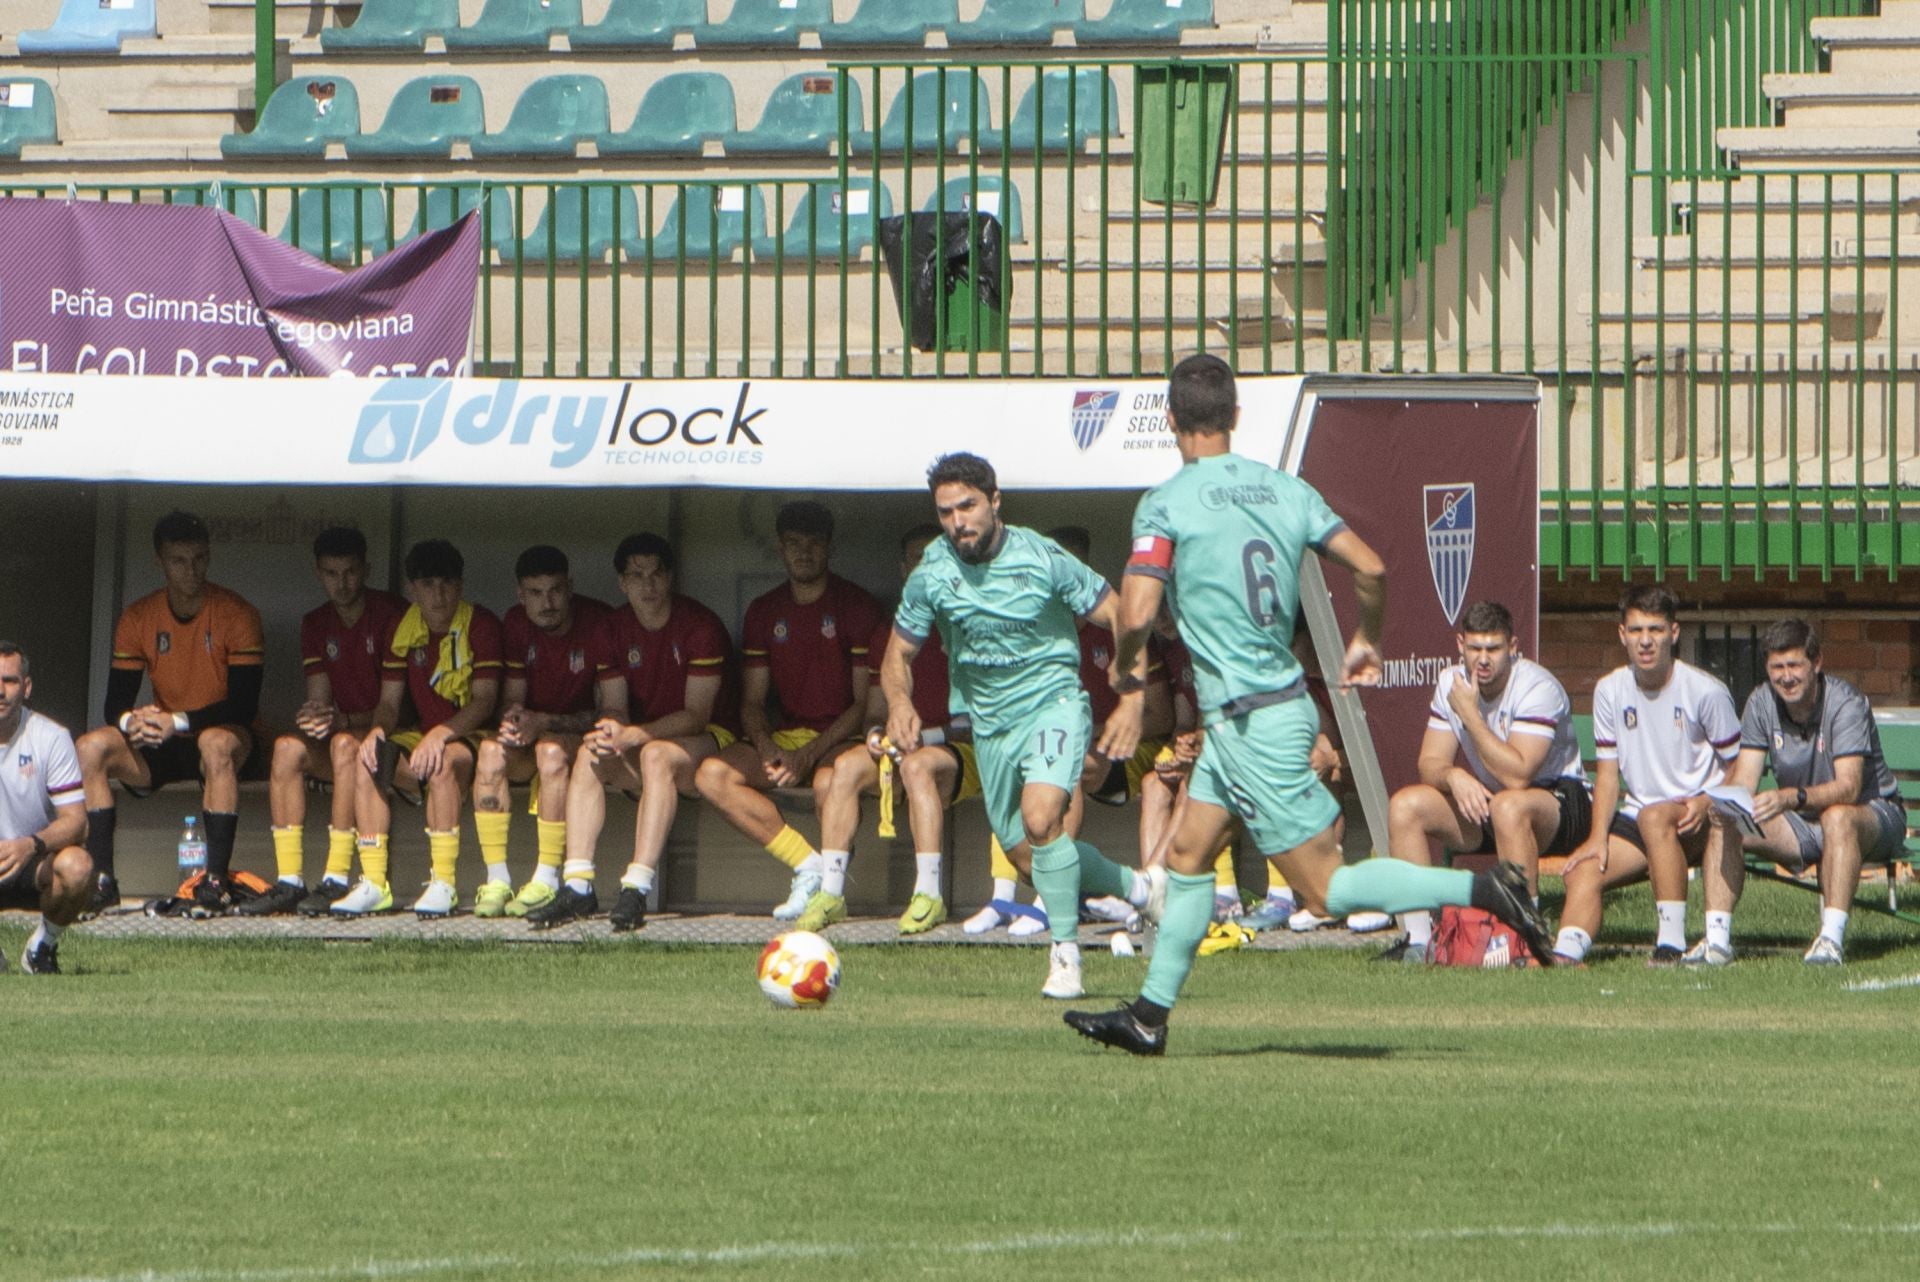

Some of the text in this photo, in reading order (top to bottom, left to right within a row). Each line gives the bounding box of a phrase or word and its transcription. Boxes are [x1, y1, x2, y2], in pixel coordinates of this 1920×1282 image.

[51, 288, 414, 348] Peña Gimnástic egoviana
[603, 450, 764, 465] TECHNOLOGIES
[1123, 439, 1155, 449] DESDE
[1242, 538, 1281, 629] 6
[1039, 728, 1068, 756] 17
